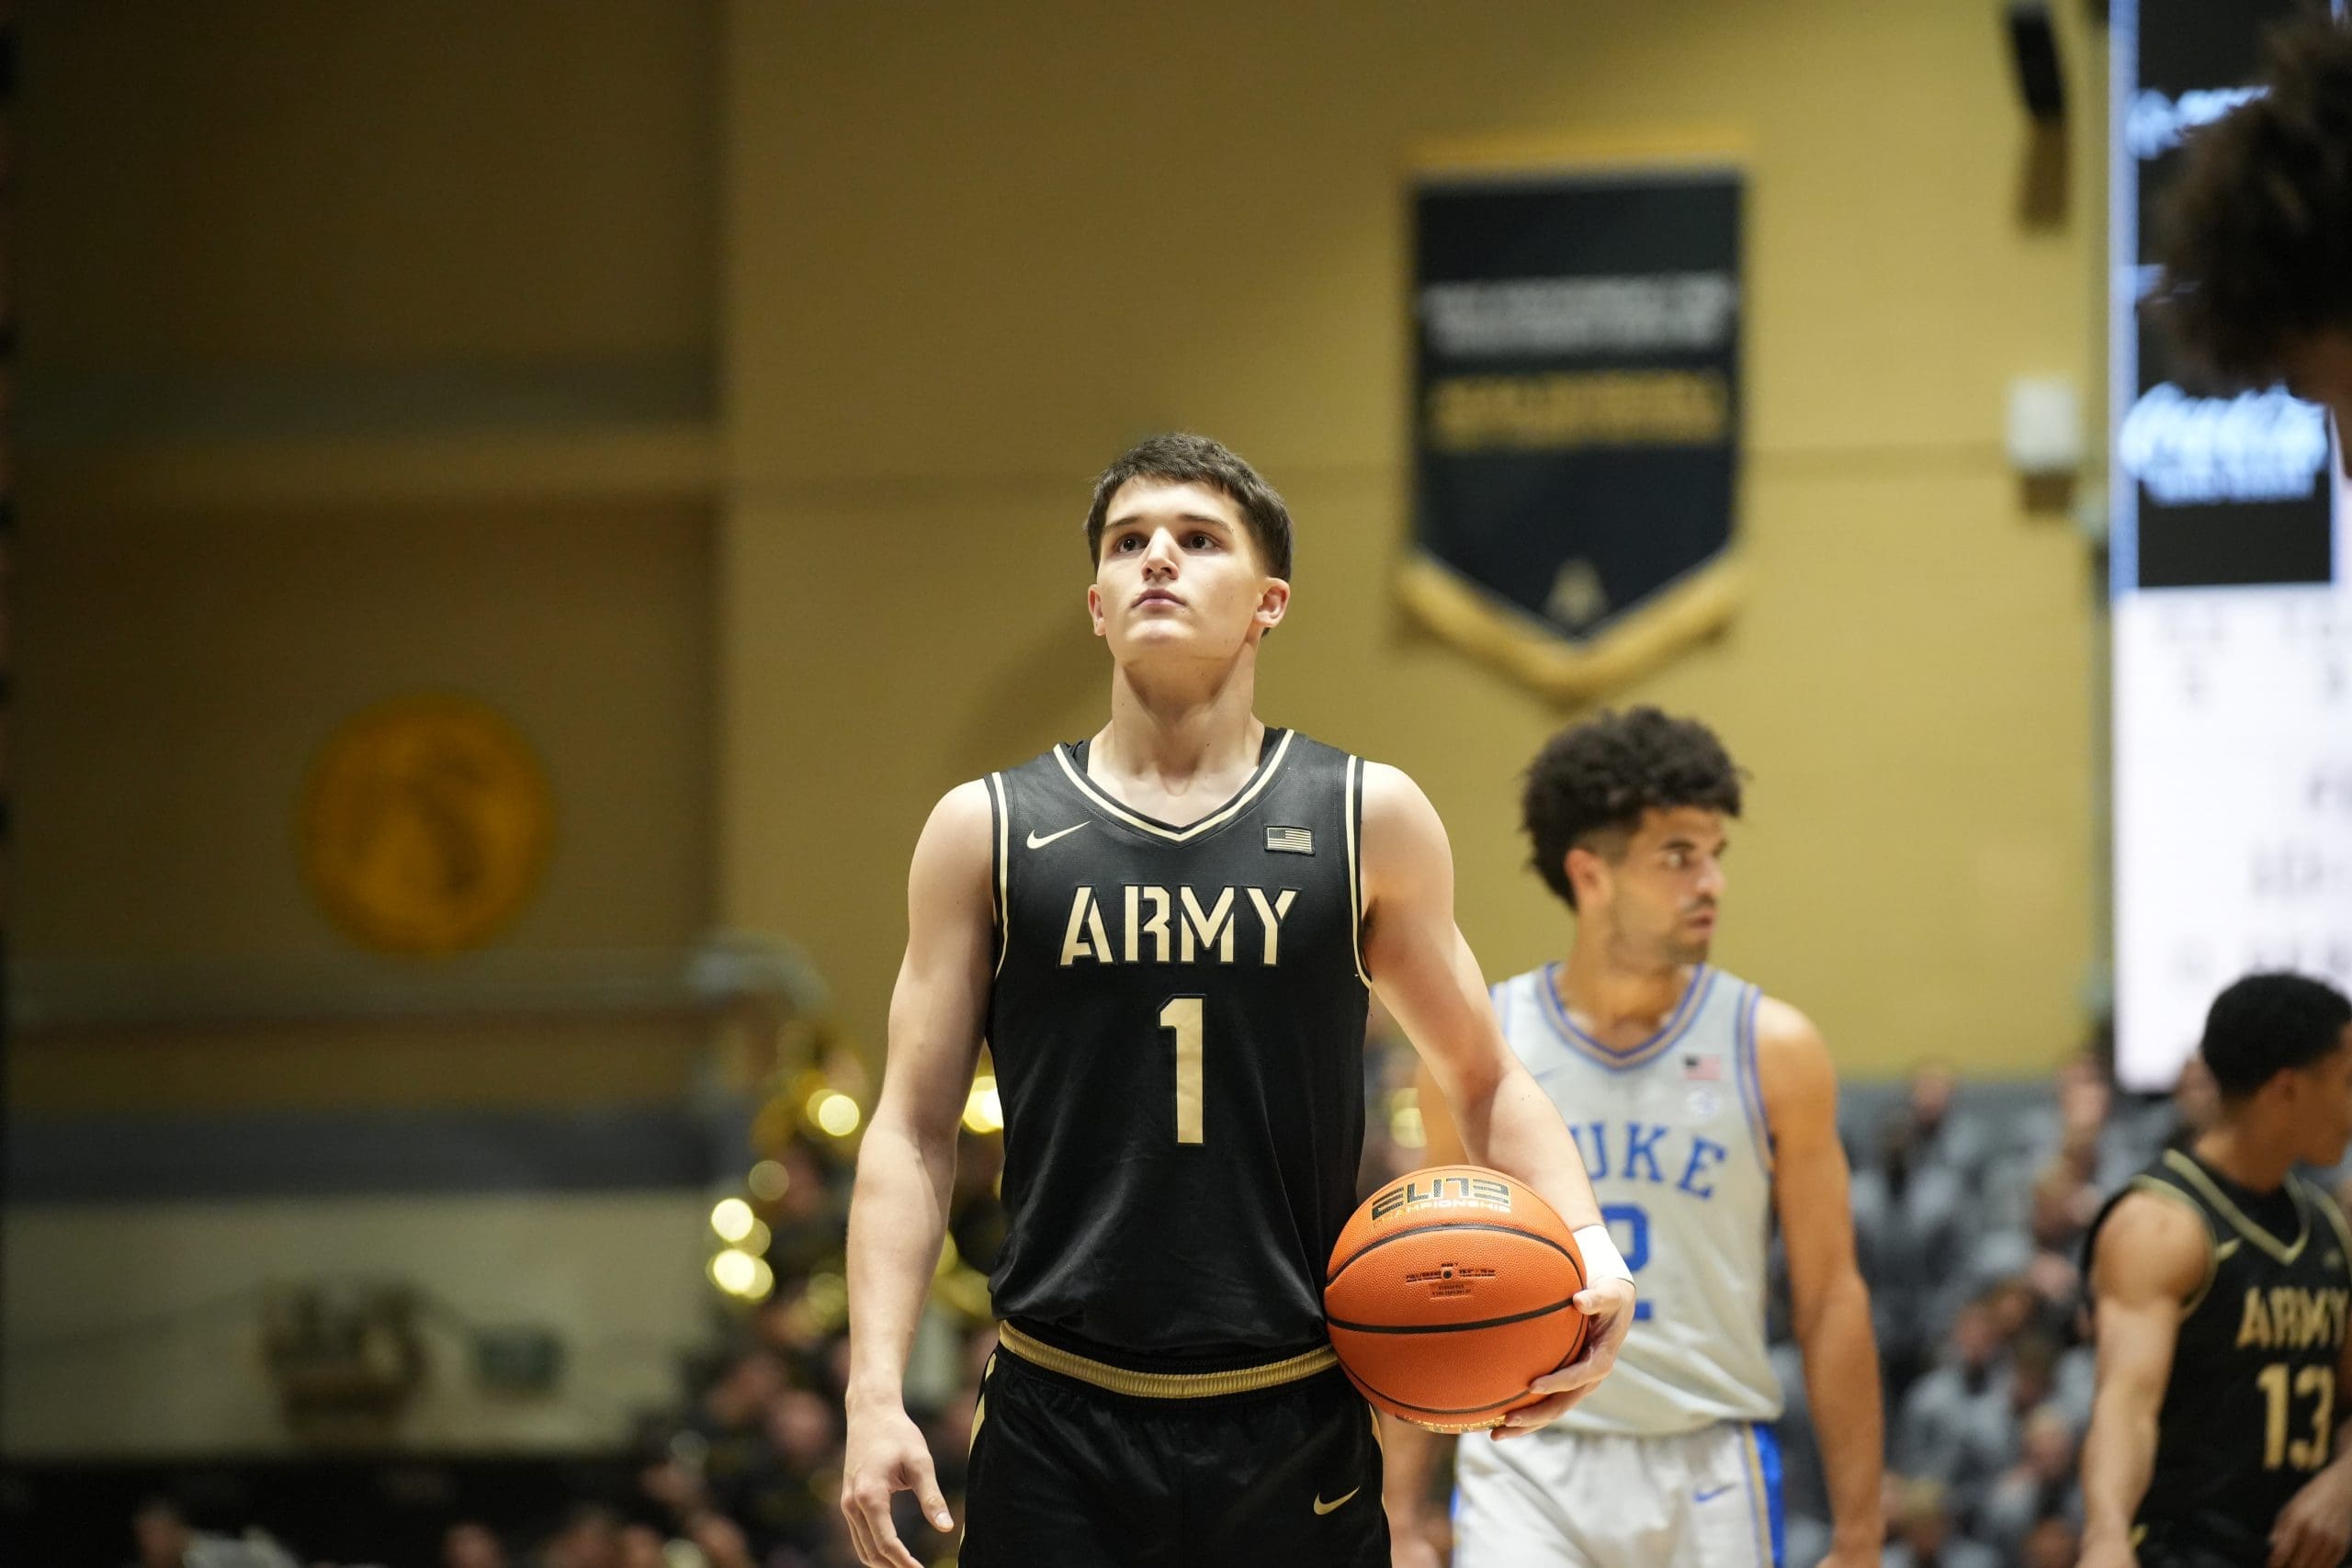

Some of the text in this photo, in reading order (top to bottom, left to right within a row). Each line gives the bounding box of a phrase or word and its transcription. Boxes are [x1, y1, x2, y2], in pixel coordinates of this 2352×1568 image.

[1059, 885, 1297, 965] ARMY
[1159, 998, 1204, 1144] 1
[1372, 1177, 1511, 1221] ELITE
[1569, 1121, 1727, 1200] UKE
[2235, 1286, 2349, 1349] ARMY
[2256, 1363, 2335, 1470] 13
